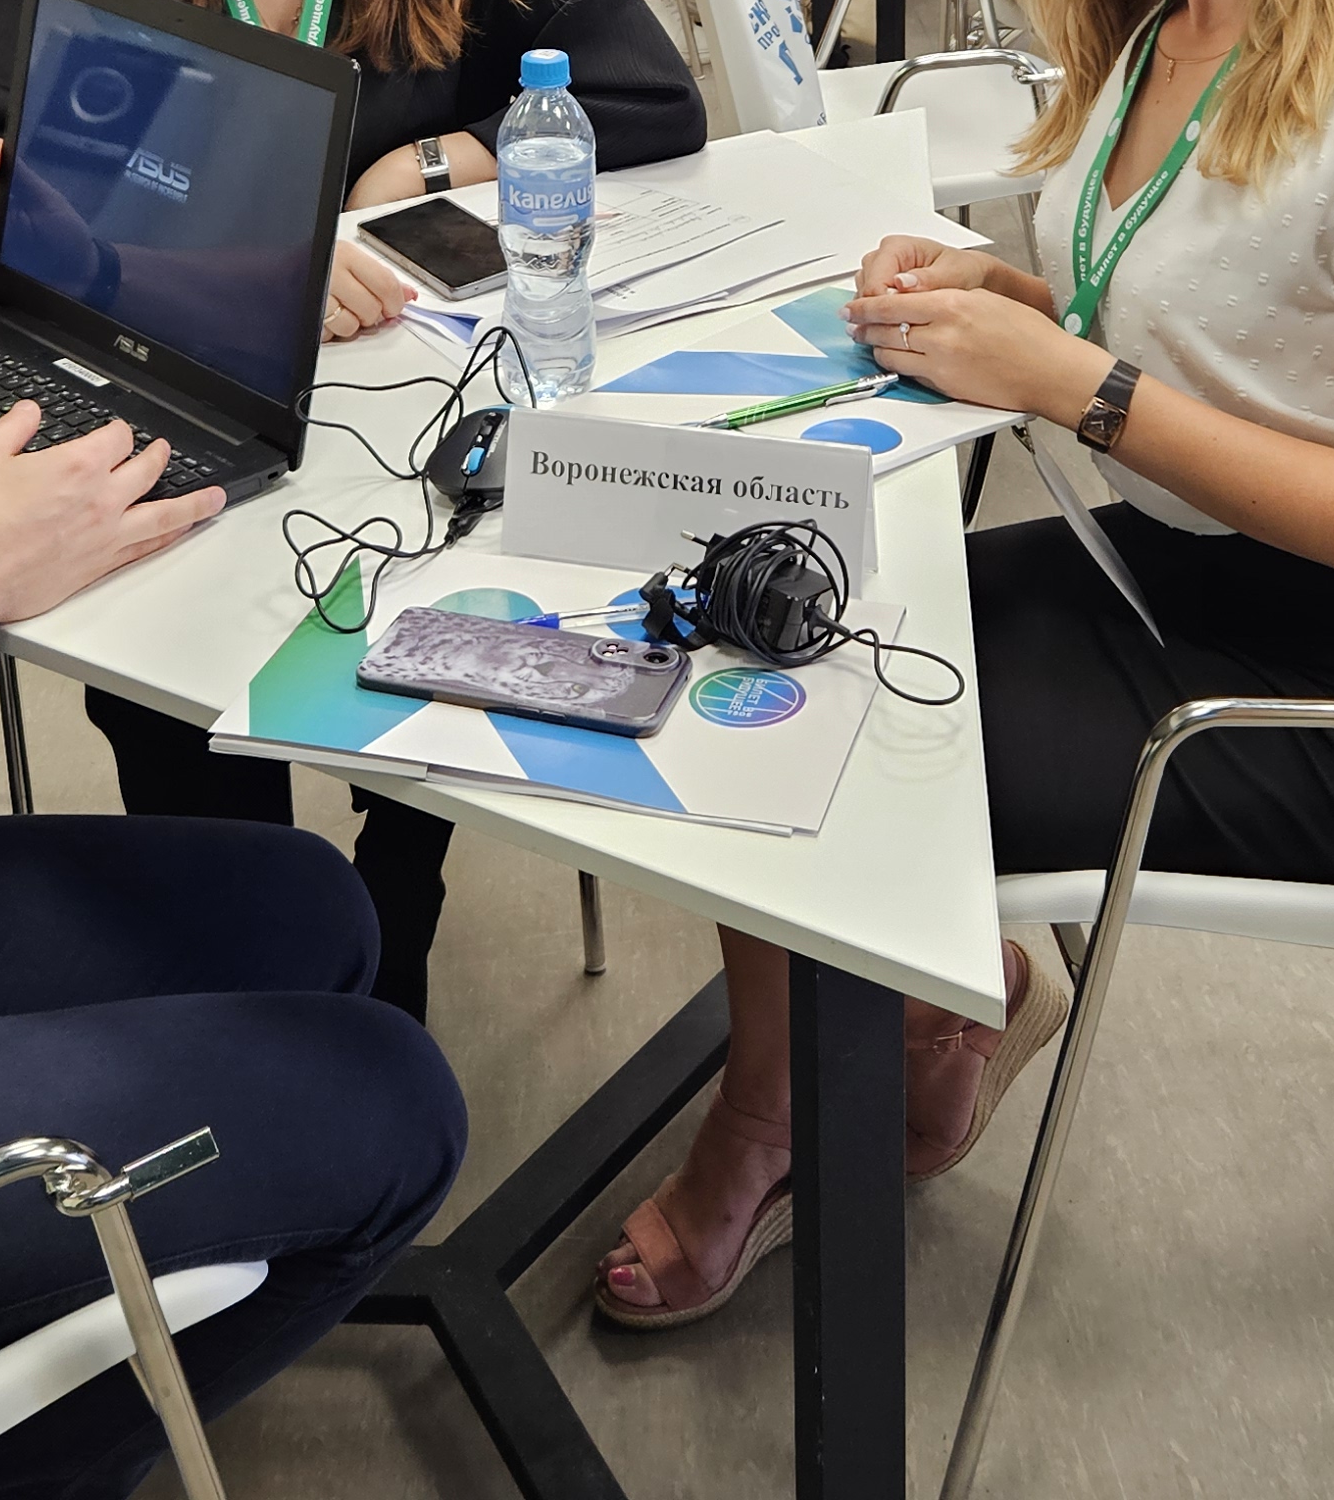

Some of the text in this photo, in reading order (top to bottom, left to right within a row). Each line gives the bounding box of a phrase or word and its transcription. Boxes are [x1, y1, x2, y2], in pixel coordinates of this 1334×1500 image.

[509, 184, 593, 210] капелия
[1077, 168, 1100, 282] лет в будущее
[1089, 169, 1169, 288] Билет в будущее
[113, 334, 150, 363] ASUS
[530, 449, 850, 510] Воронежская область
